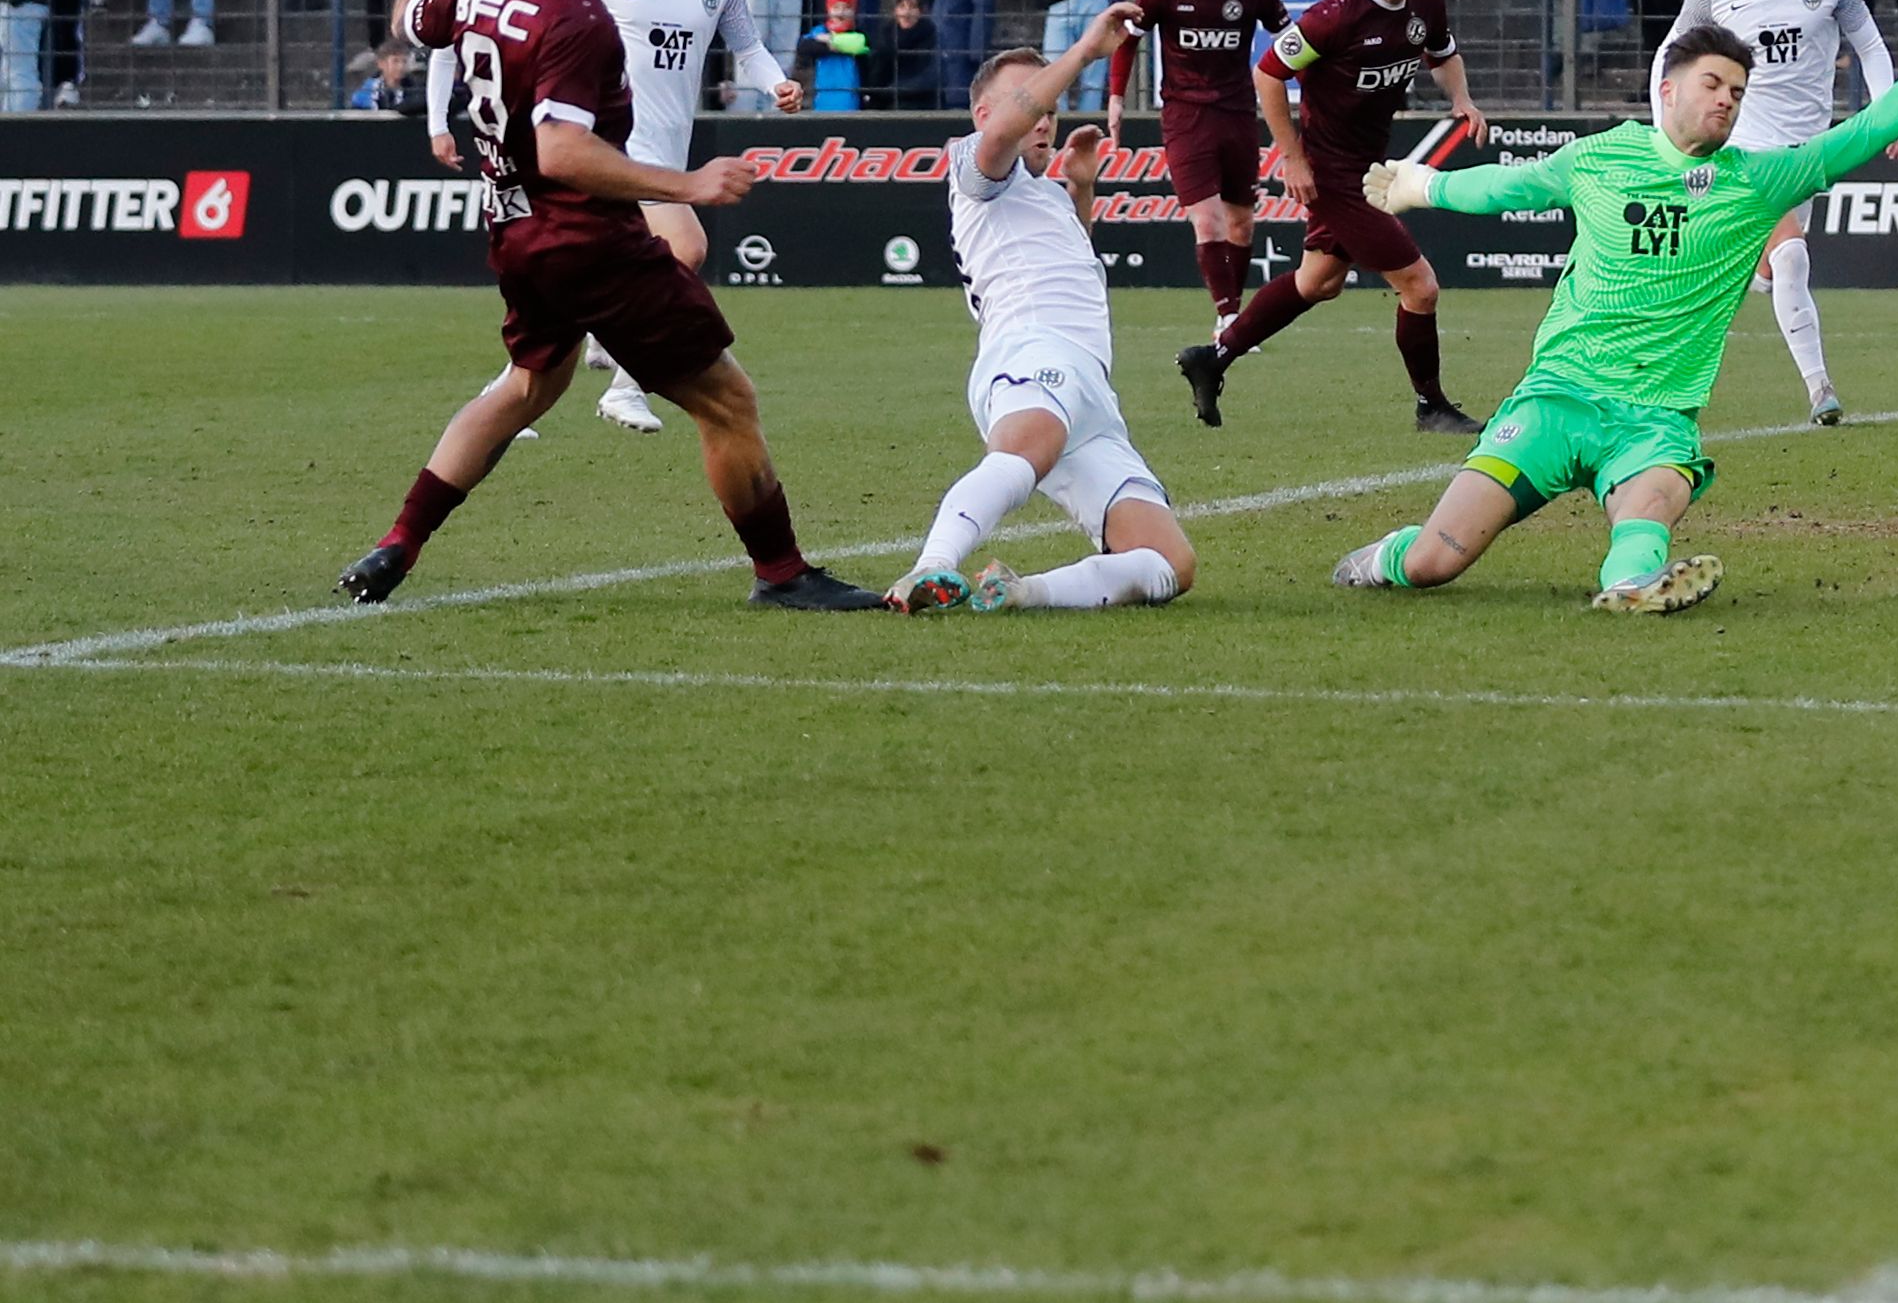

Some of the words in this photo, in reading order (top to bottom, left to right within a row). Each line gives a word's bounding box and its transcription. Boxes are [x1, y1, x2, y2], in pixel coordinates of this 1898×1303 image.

[1179, 30, 1241, 49] DWB
[654, 49, 687, 71] LY!
[1766, 45, 1798, 64] LY!
[460, 30, 509, 144] 8
[1489, 125, 1576, 145] Potsdam
[1631, 228, 1681, 257] LY!
[1466, 253, 1568, 268] CHEVROLE
